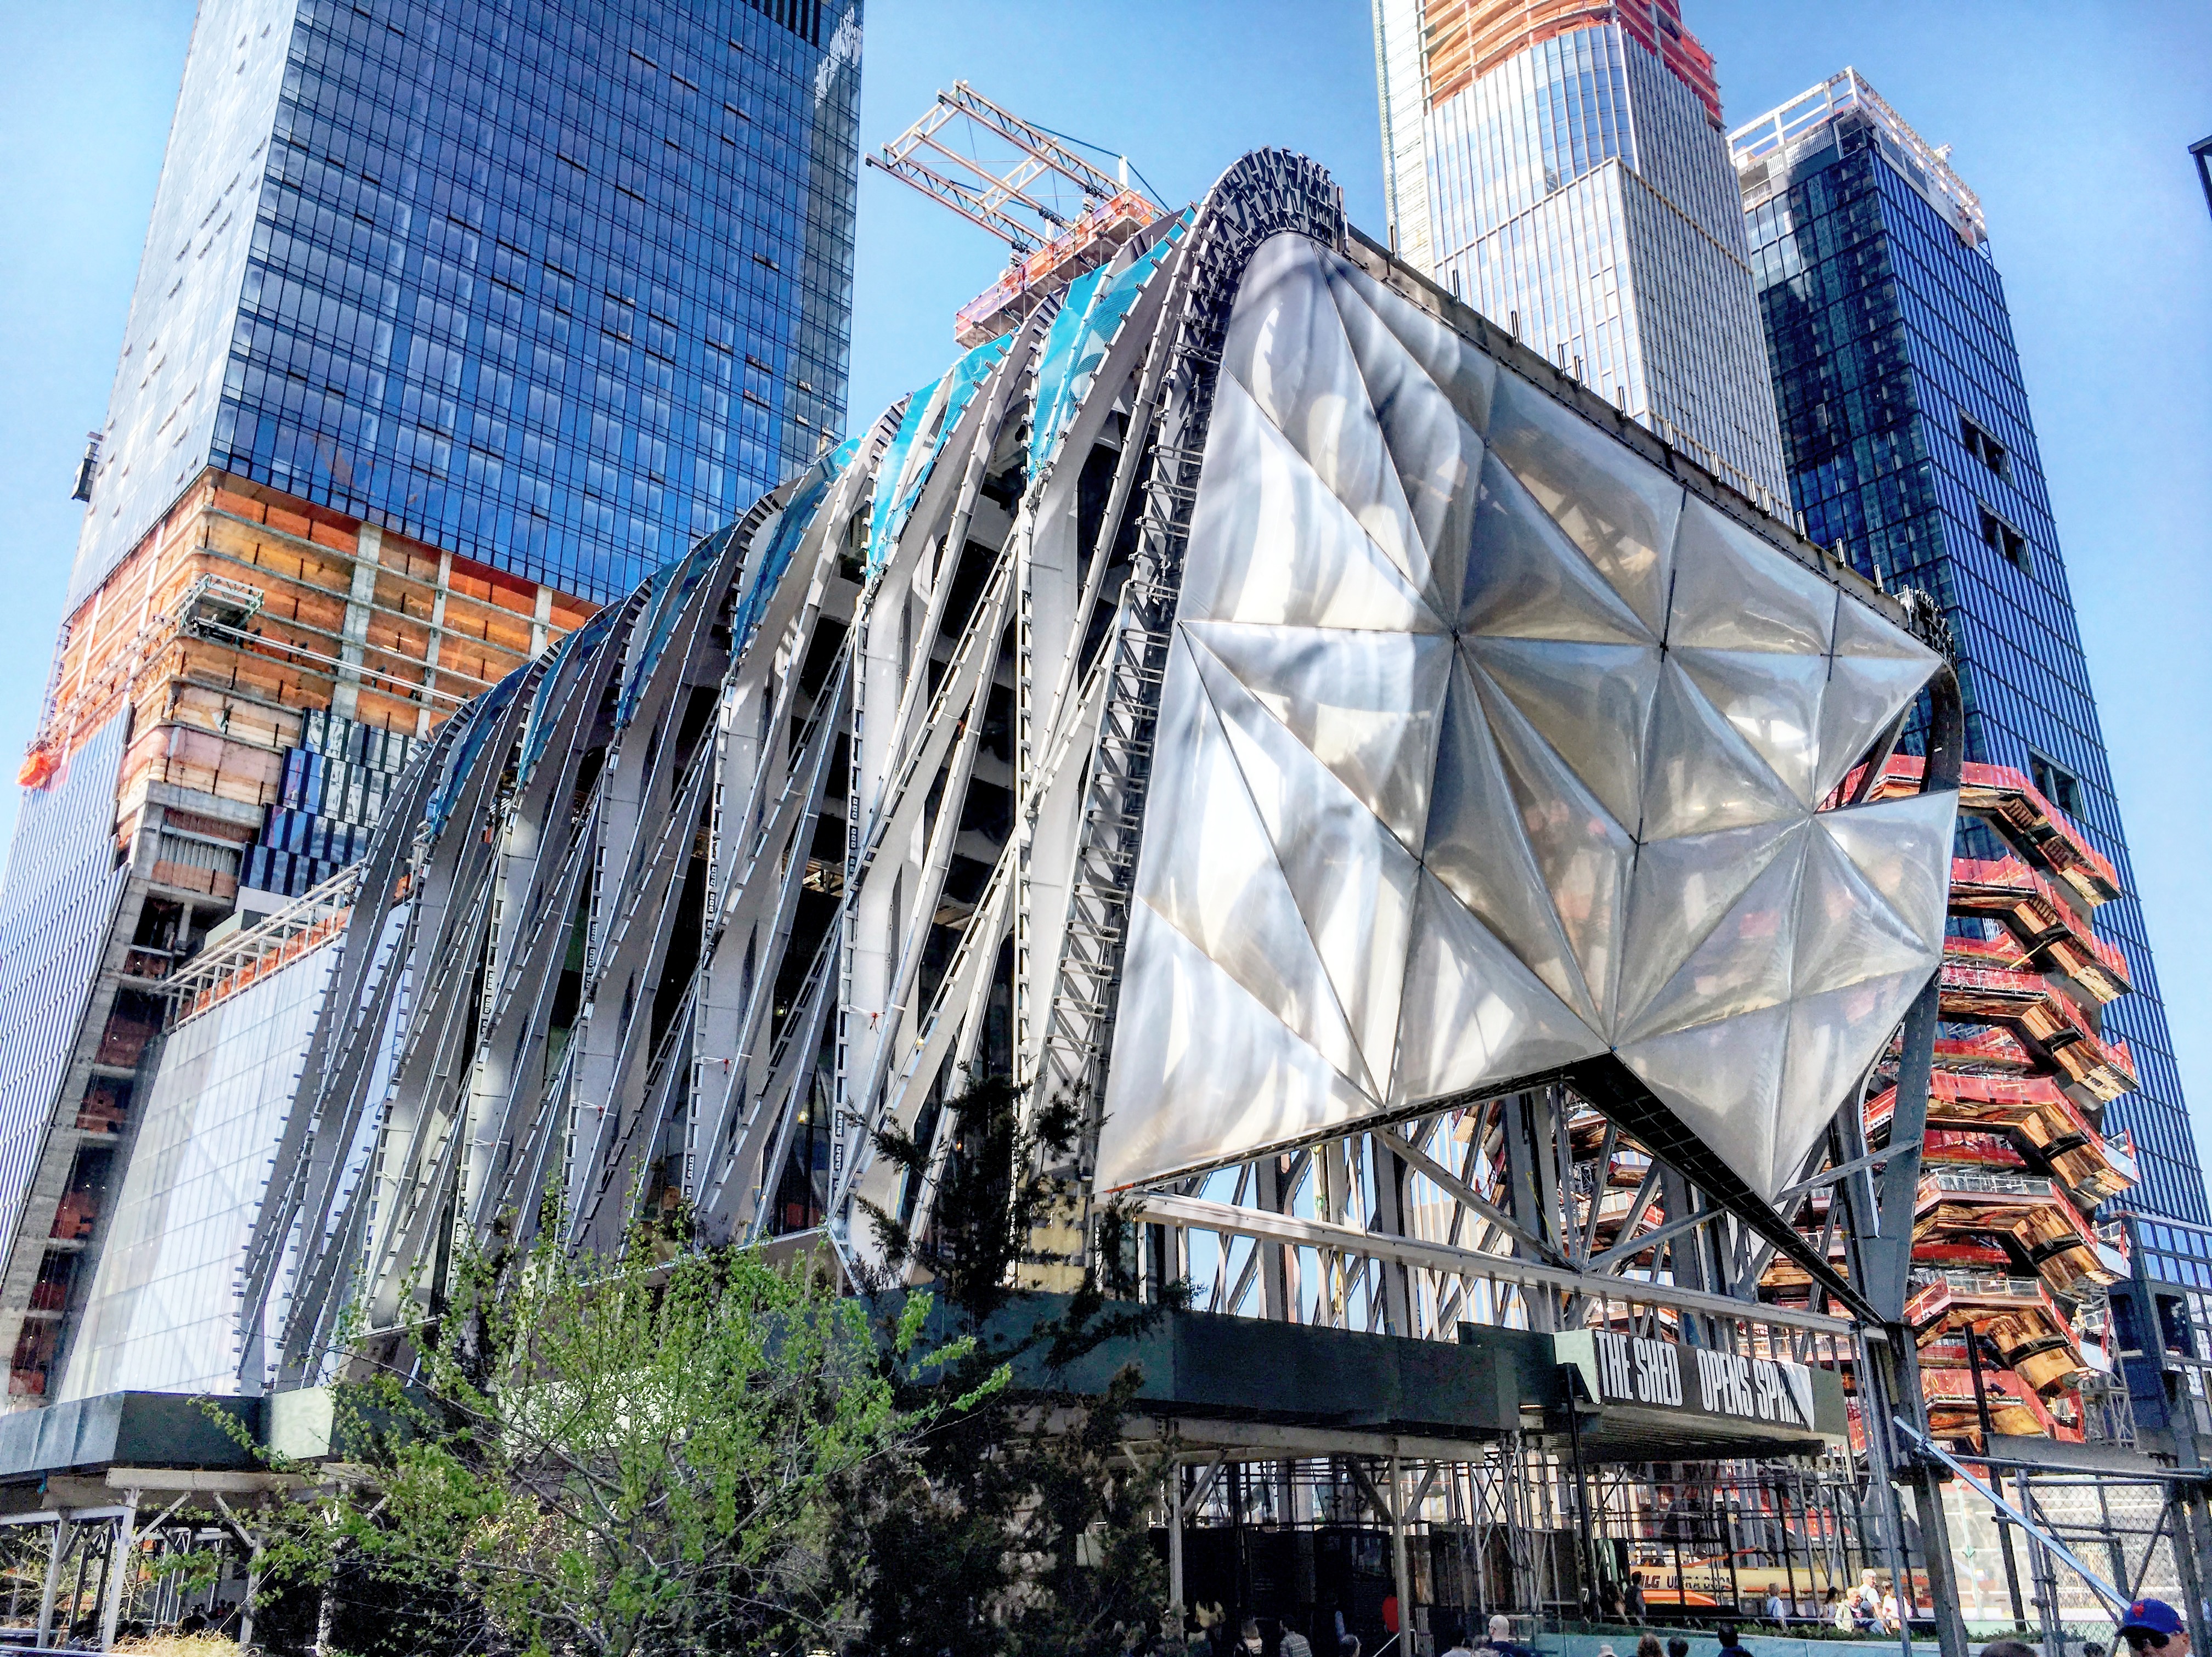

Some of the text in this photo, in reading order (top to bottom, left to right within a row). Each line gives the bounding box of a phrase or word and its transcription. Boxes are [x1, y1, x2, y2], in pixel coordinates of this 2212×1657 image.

[1595, 1331, 1804, 1425] THE SHED OPENS SPR
[1667, 1575, 1700, 1589] ULRA
